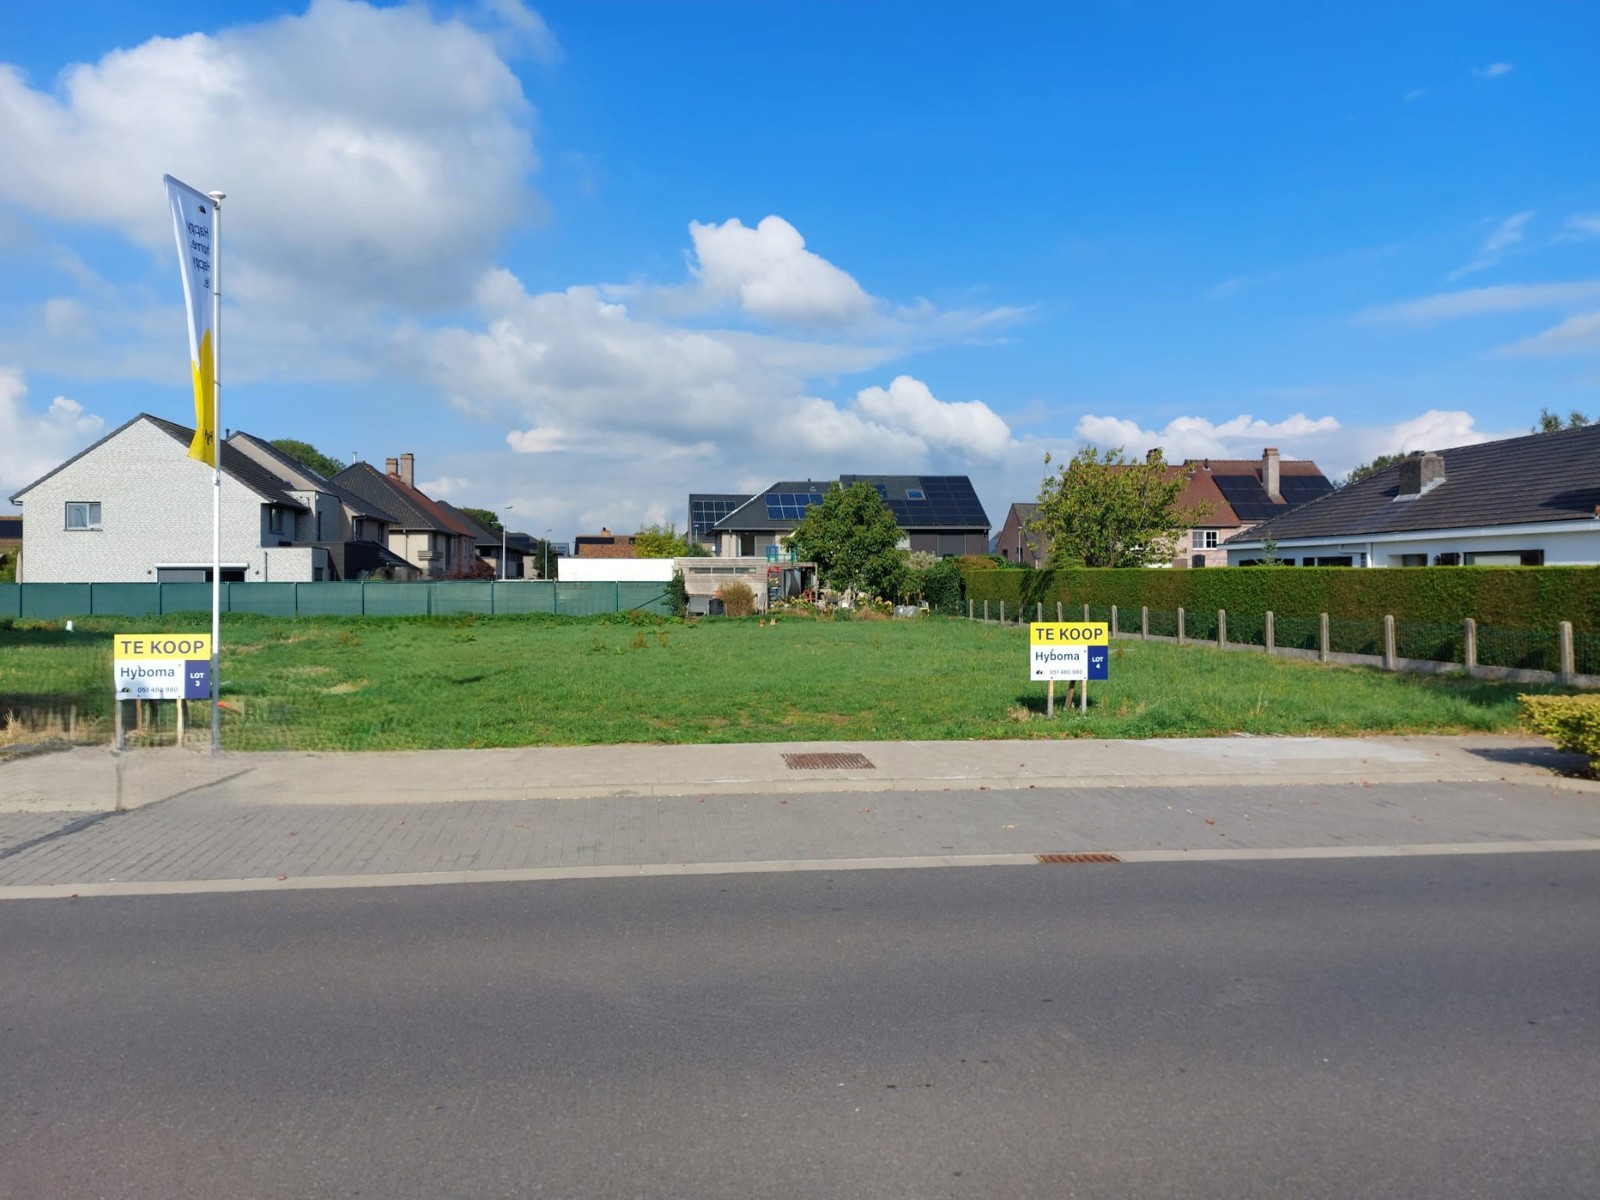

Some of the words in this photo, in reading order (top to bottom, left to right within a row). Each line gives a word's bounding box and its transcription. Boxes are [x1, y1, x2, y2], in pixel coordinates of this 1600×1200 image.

[1035, 628, 1054, 640] TE
[1059, 628, 1103, 640] KOOP
[120, 640, 144, 654] TE
[150, 640, 204, 654] KOOP
[1035, 651, 1080, 663] Hyboma
[120, 666, 175, 680] Hyboma
